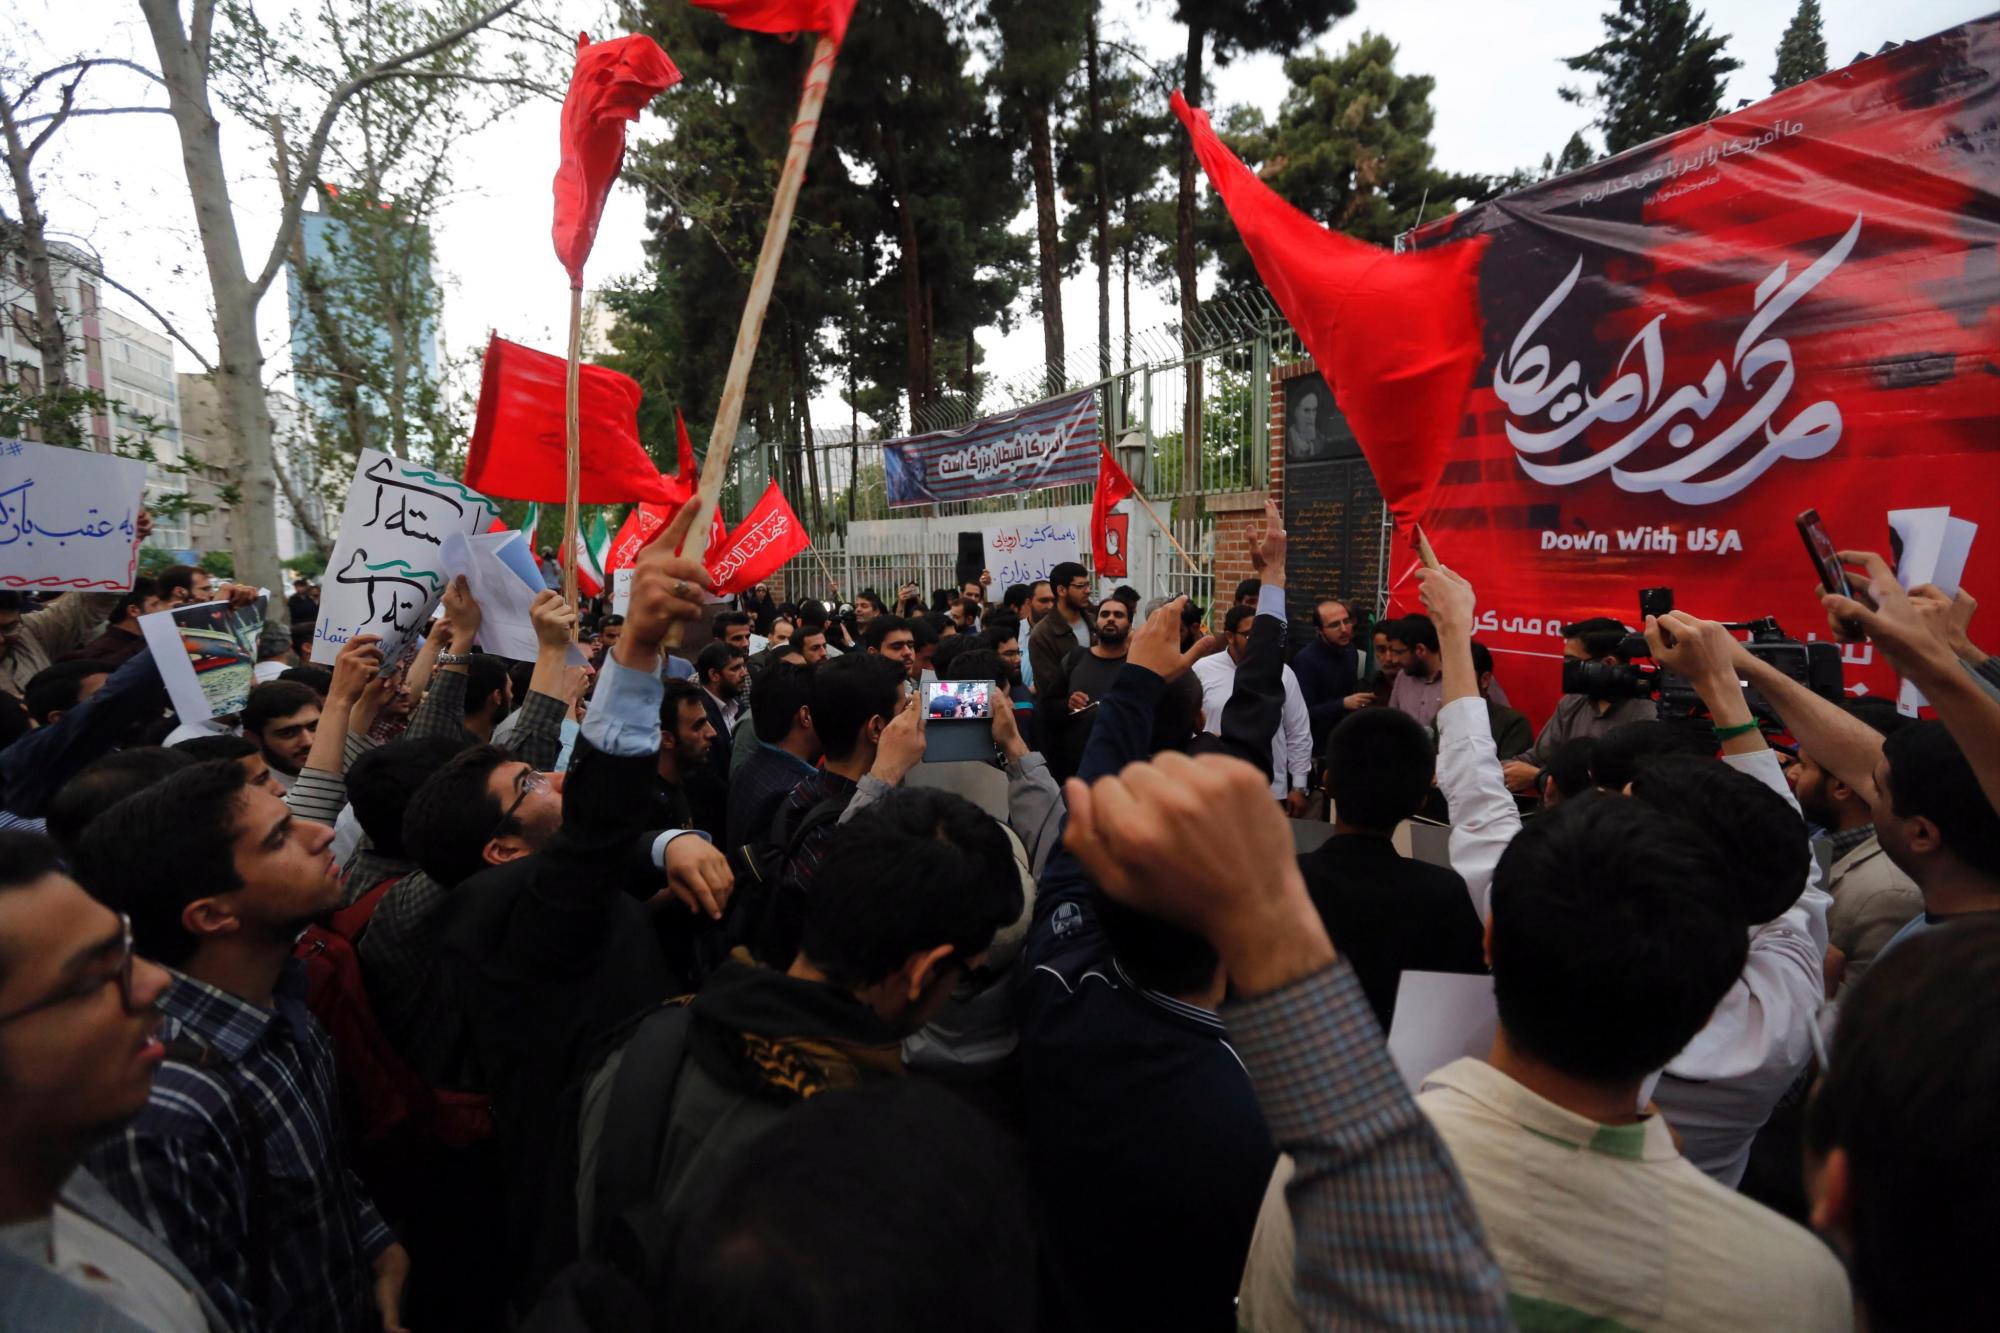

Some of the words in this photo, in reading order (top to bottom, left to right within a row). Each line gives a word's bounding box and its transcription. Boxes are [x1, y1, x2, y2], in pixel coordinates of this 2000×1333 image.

[1722, 120, 1782, 158] آمریکا
[1783, 120, 1804, 138] ما
[1707, 144, 1720, 168] را
[1634, 167, 1665, 190] می
[1611, 209, 1862, 505] مرگ
[941, 451, 965, 475] است
[965, 446, 992, 476] بزرگ
[991, 436, 1025, 470] شیطان
[34, 508, 114, 547] عقب
[118, 506, 134, 543] به
[1019, 524, 1054, 550] کشور
[1047, 527, 1067, 542] سه
[1065, 526, 1077, 546] به
[1616, 525, 1678, 555] With
[1686, 527, 1744, 555] USA
[1501, 616, 1543, 636] می
